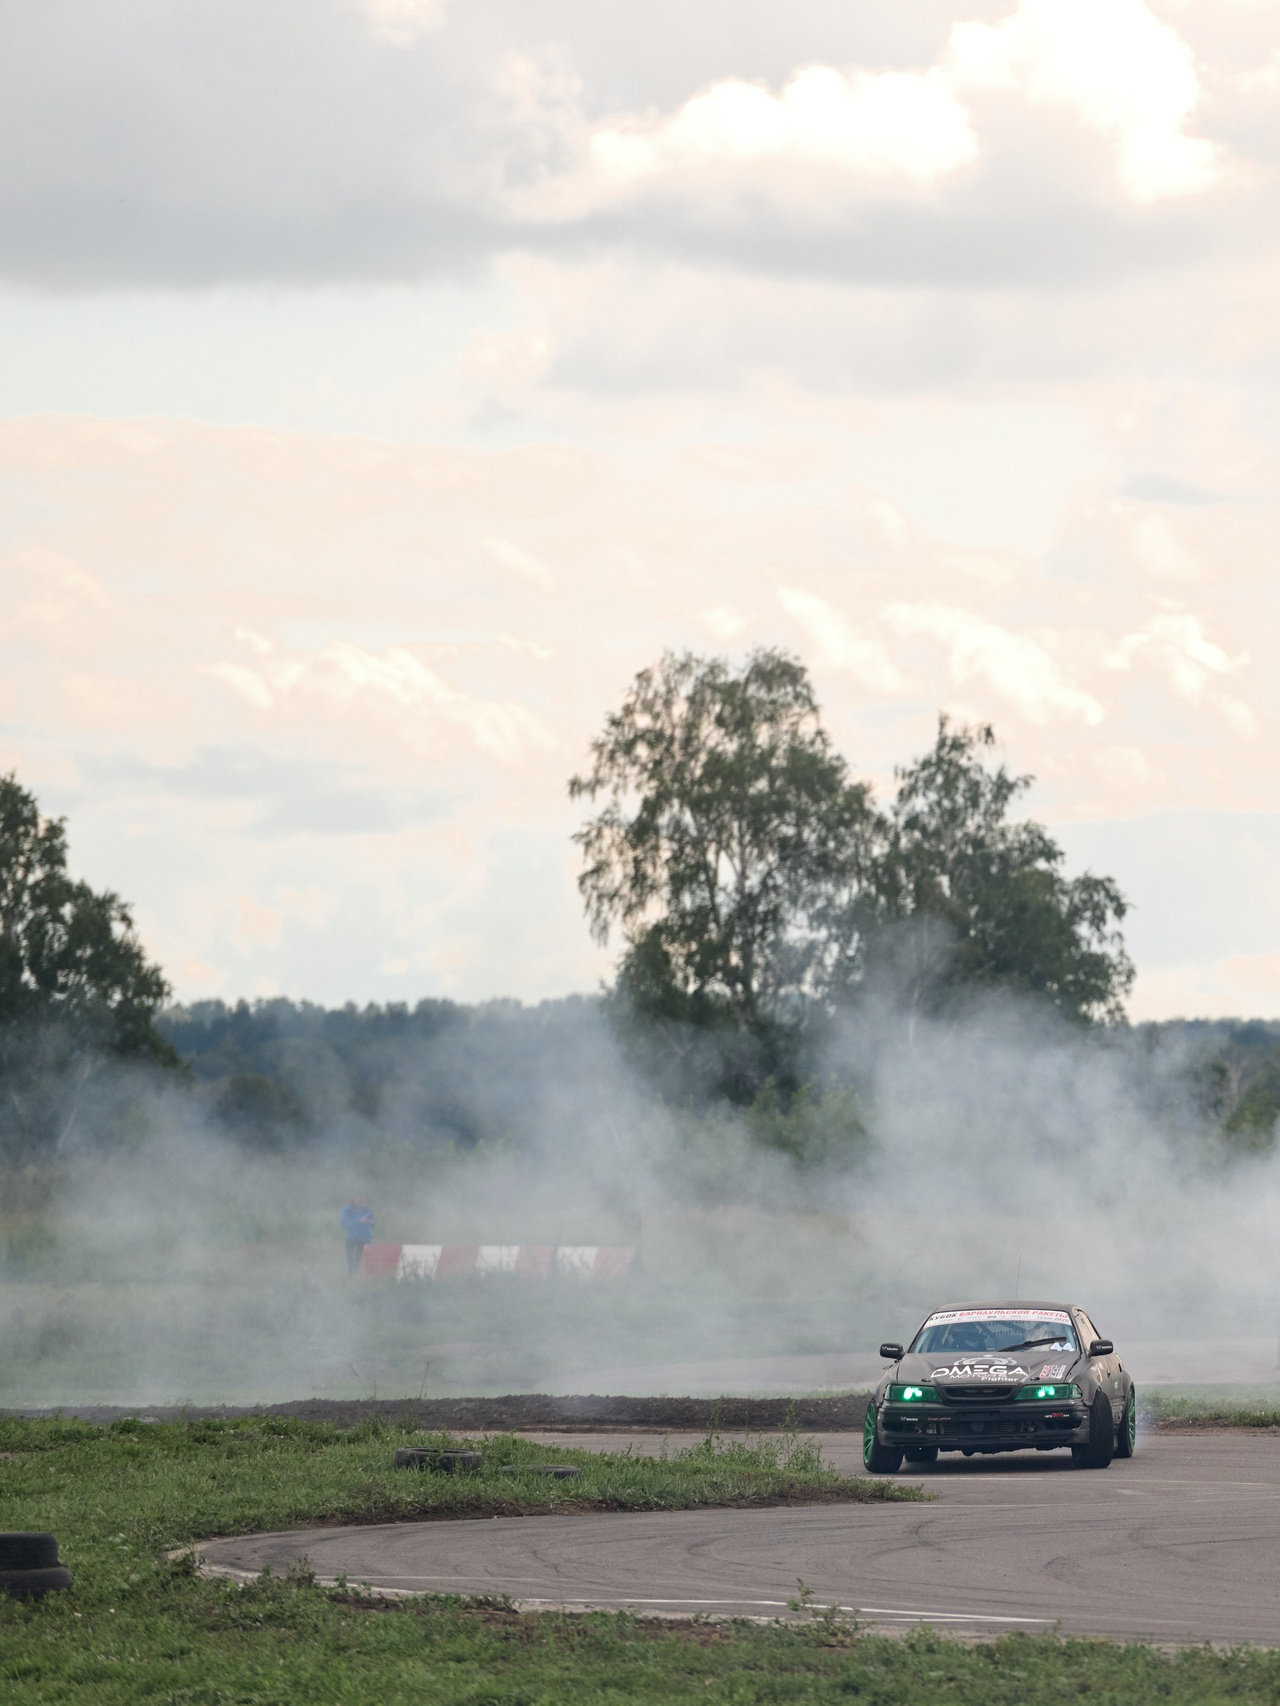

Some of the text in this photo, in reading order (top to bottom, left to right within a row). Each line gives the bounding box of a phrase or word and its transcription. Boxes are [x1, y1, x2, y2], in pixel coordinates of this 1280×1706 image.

[1031, 1310, 1069, 1319] РАКЕТЫ
[1050, 1342, 1076, 1352] 44
[931, 1365, 1029, 1378] OMEGA
